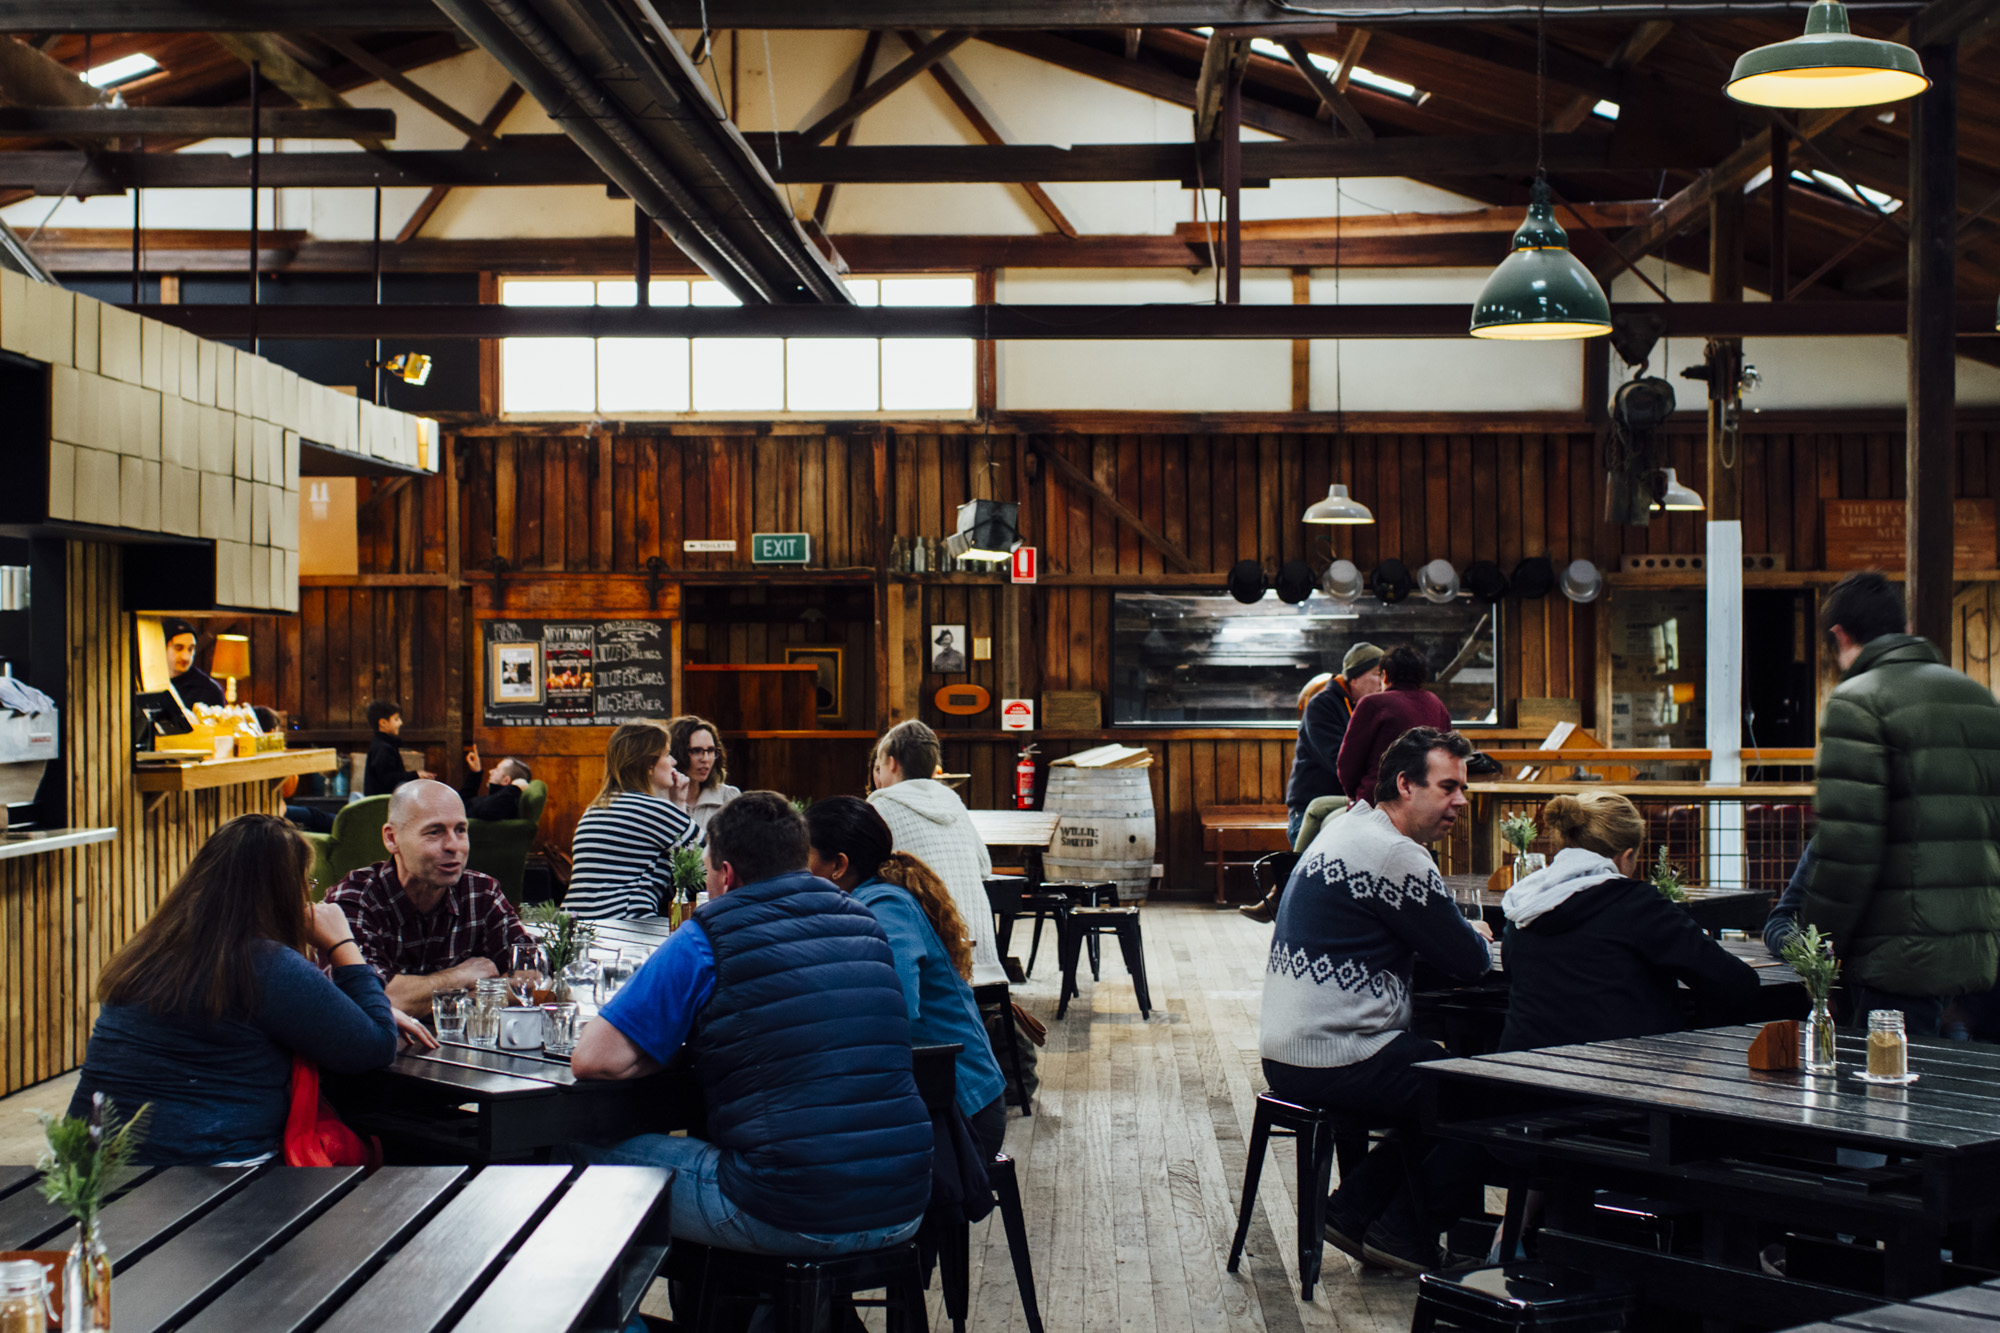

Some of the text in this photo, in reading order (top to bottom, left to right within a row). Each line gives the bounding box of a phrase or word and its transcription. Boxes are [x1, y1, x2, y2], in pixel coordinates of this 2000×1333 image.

[1841, 504, 1866, 514] THE
[1839, 516, 1881, 527] APPLE
[763, 539, 797, 557] EXIT
[1060, 826, 1099, 837] WILLIE
